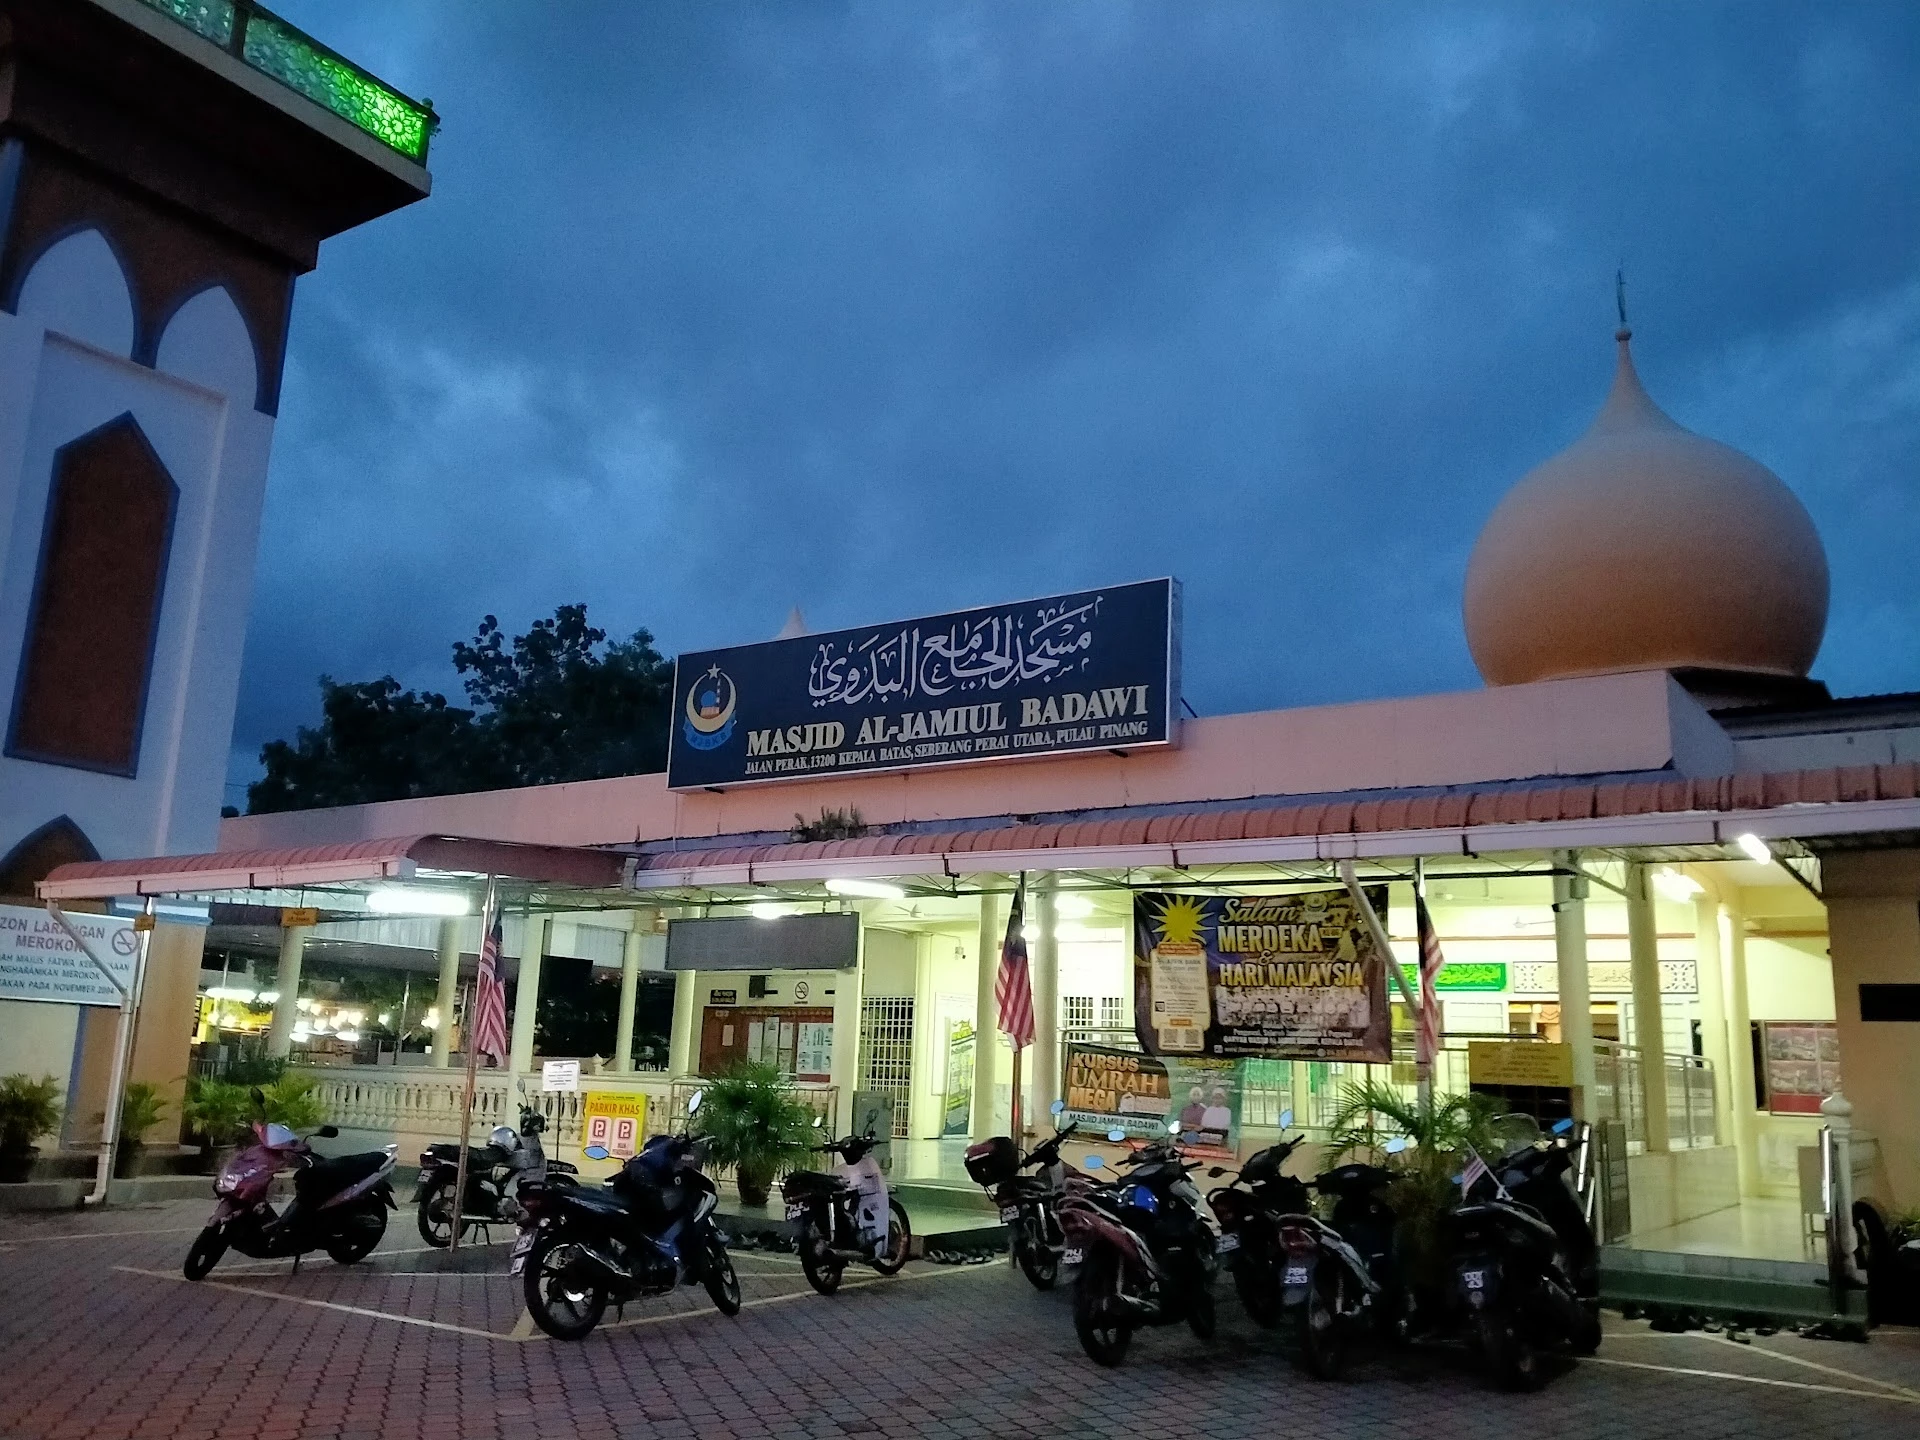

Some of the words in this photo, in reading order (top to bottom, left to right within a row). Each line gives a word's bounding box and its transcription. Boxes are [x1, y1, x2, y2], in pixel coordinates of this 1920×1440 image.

[746, 721, 845, 757] MASJID
[854, 702, 1007, 746] AL-JAMIUL
[1019, 684, 1150, 728] BADAWI
[744, 759, 774, 775] JALAN
[837, 749, 877, 766] KEPALA
[974, 734, 1010, 752] PERAI
[1099, 720, 1149, 740] PINANG
[1218, 897, 1300, 923] Salam
[0, 917, 28, 932] ZON
[34, 920, 105, 939] LARAGAN
[1217, 923, 1324, 953] MERDEKA
[1219, 963, 1264, 987] HARI
[1268, 961, 1365, 988] MALAYSIA
[1072, 1052, 1140, 1073] KURSUS
[1071, 1066, 1160, 1095] UMRAH
[589, 1102, 618, 1114] PARKIR
[618, 1104, 640, 1115] KHAS
[1067, 1087, 1117, 1112] MEGA
[1068, 1113, 1096, 1124] MASJID
[1126, 1120, 1159, 1131] BADAWI
